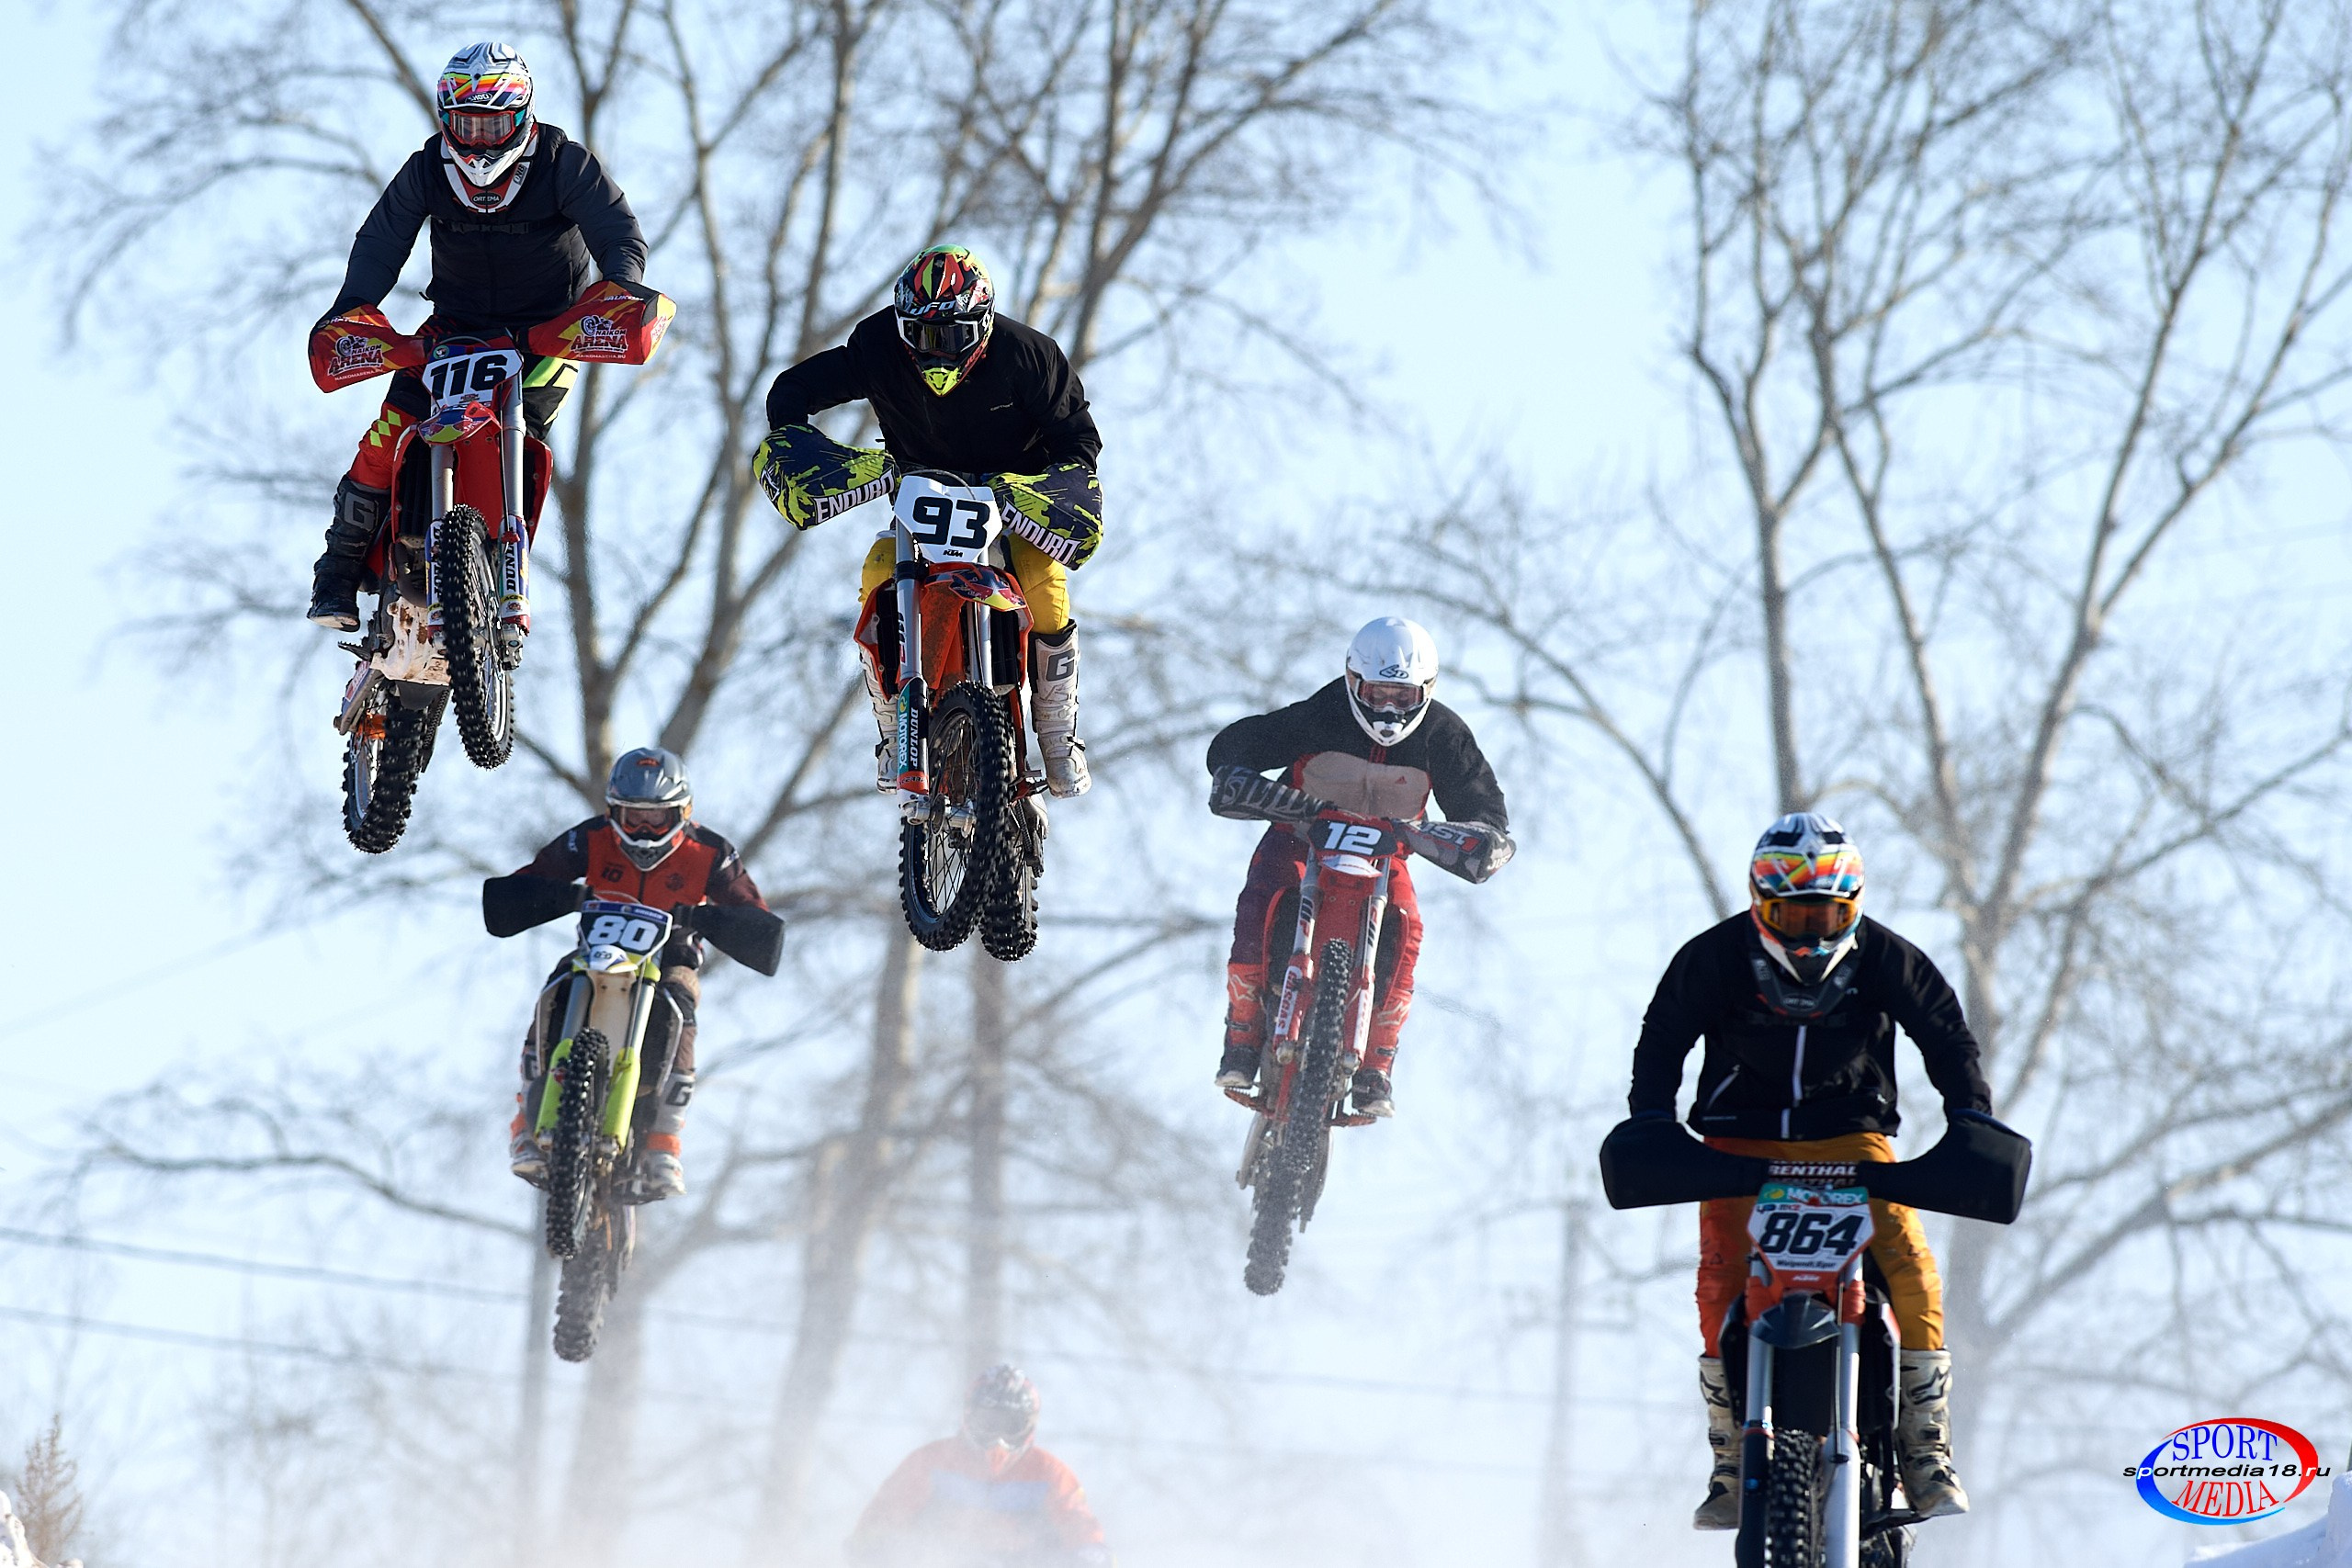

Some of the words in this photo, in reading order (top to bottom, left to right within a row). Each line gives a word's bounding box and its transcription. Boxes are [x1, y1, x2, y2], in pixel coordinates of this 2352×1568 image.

[910, 300, 956, 316] UFO
[352, 344, 382, 354] NAIKOM
[571, 333, 628, 351] ARENA
[328, 350, 384, 376] ARENA
[430, 354, 508, 400] 116
[814, 468, 896, 525] ENDURO
[912, 496, 991, 550] 93
[1001, 502, 1082, 567] ENDURO
[943, 549, 964, 558] KTM
[899, 713, 908, 770] MOTOREX
[910, 706, 919, 769] DUNLOP
[1324, 821, 1383, 856] 12
[587, 915, 660, 952] 80
[1768, 1165, 1858, 1176] RENTHAL
[1759, 1212, 1865, 1256] 864
